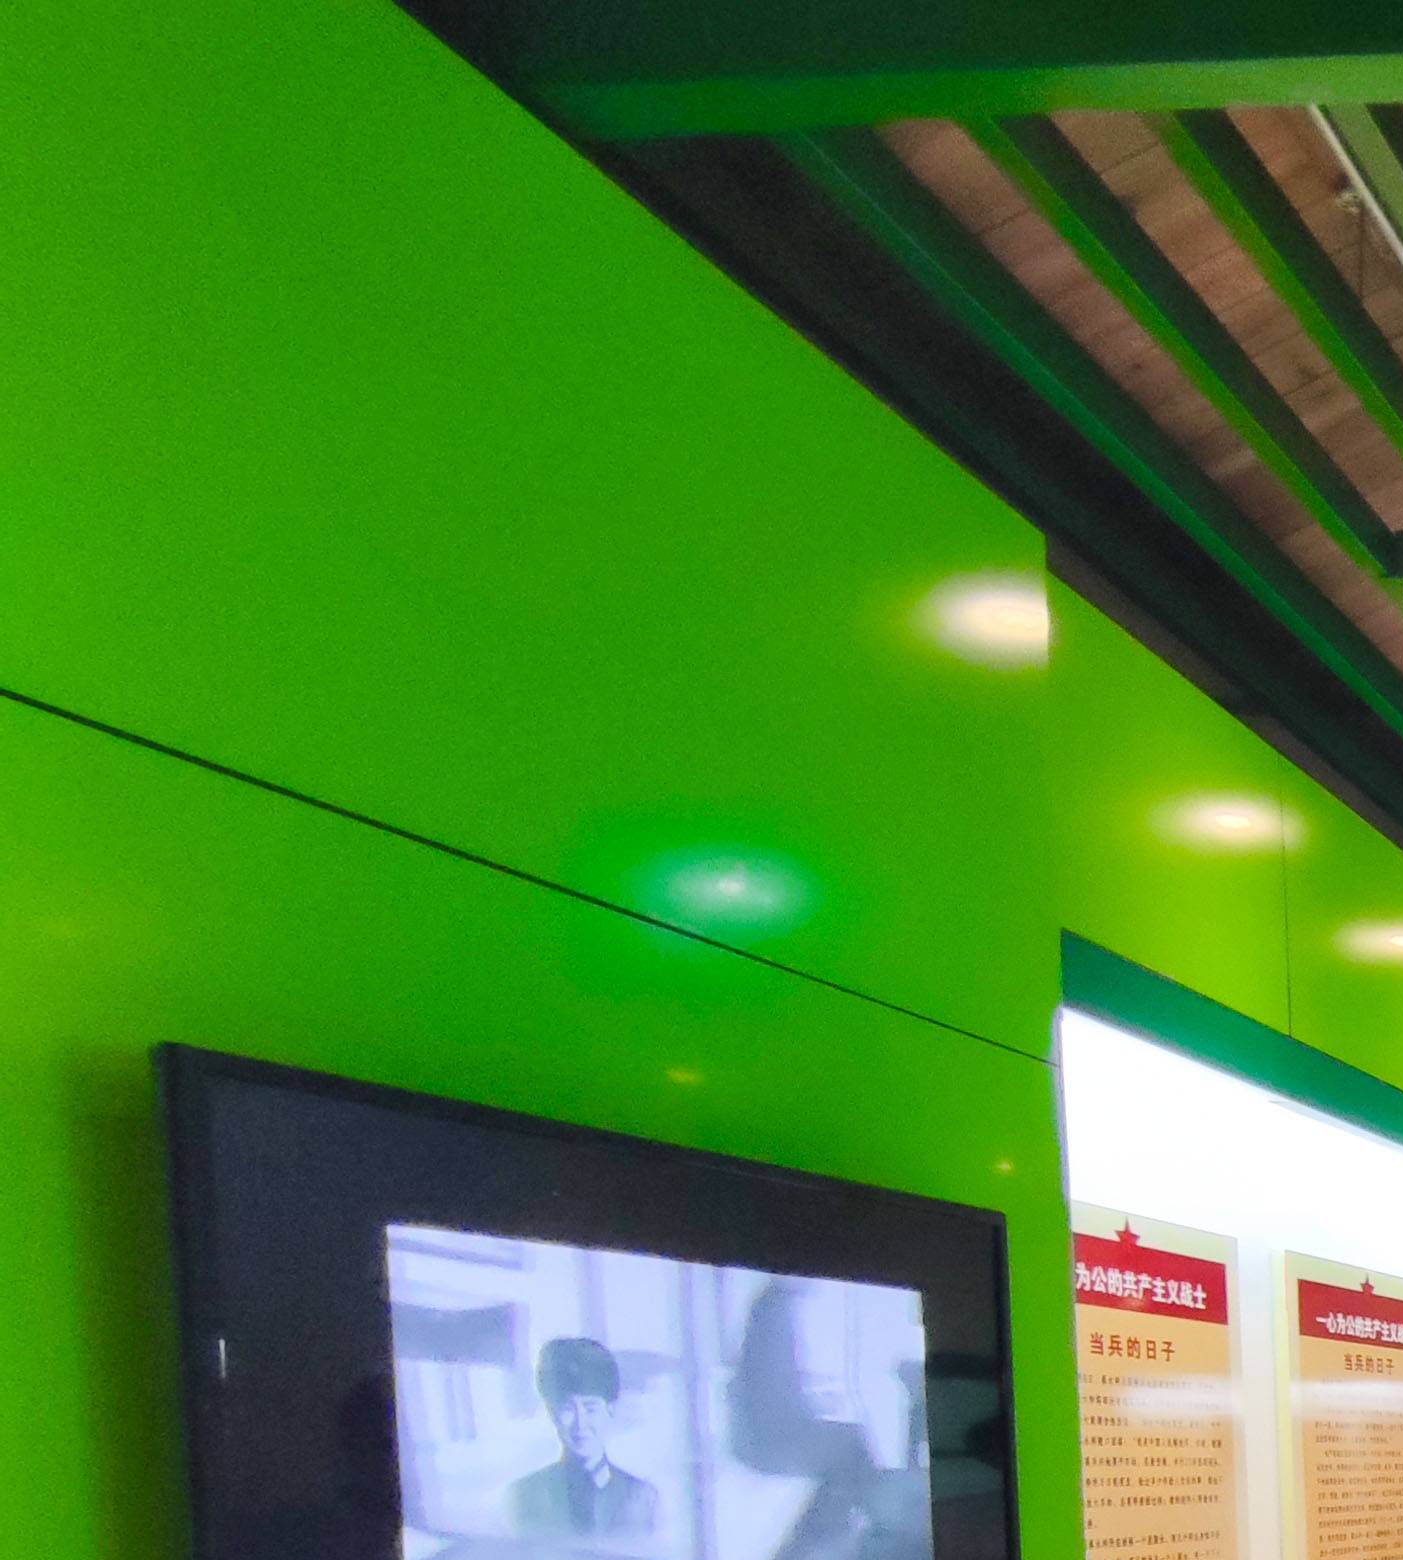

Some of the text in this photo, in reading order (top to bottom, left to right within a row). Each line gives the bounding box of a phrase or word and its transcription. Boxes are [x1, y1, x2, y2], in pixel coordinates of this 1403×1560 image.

[1090, 1331, 1175, 1362] 当兵的日子
[1344, 1352, 1395, 1375] 当兵的日子
